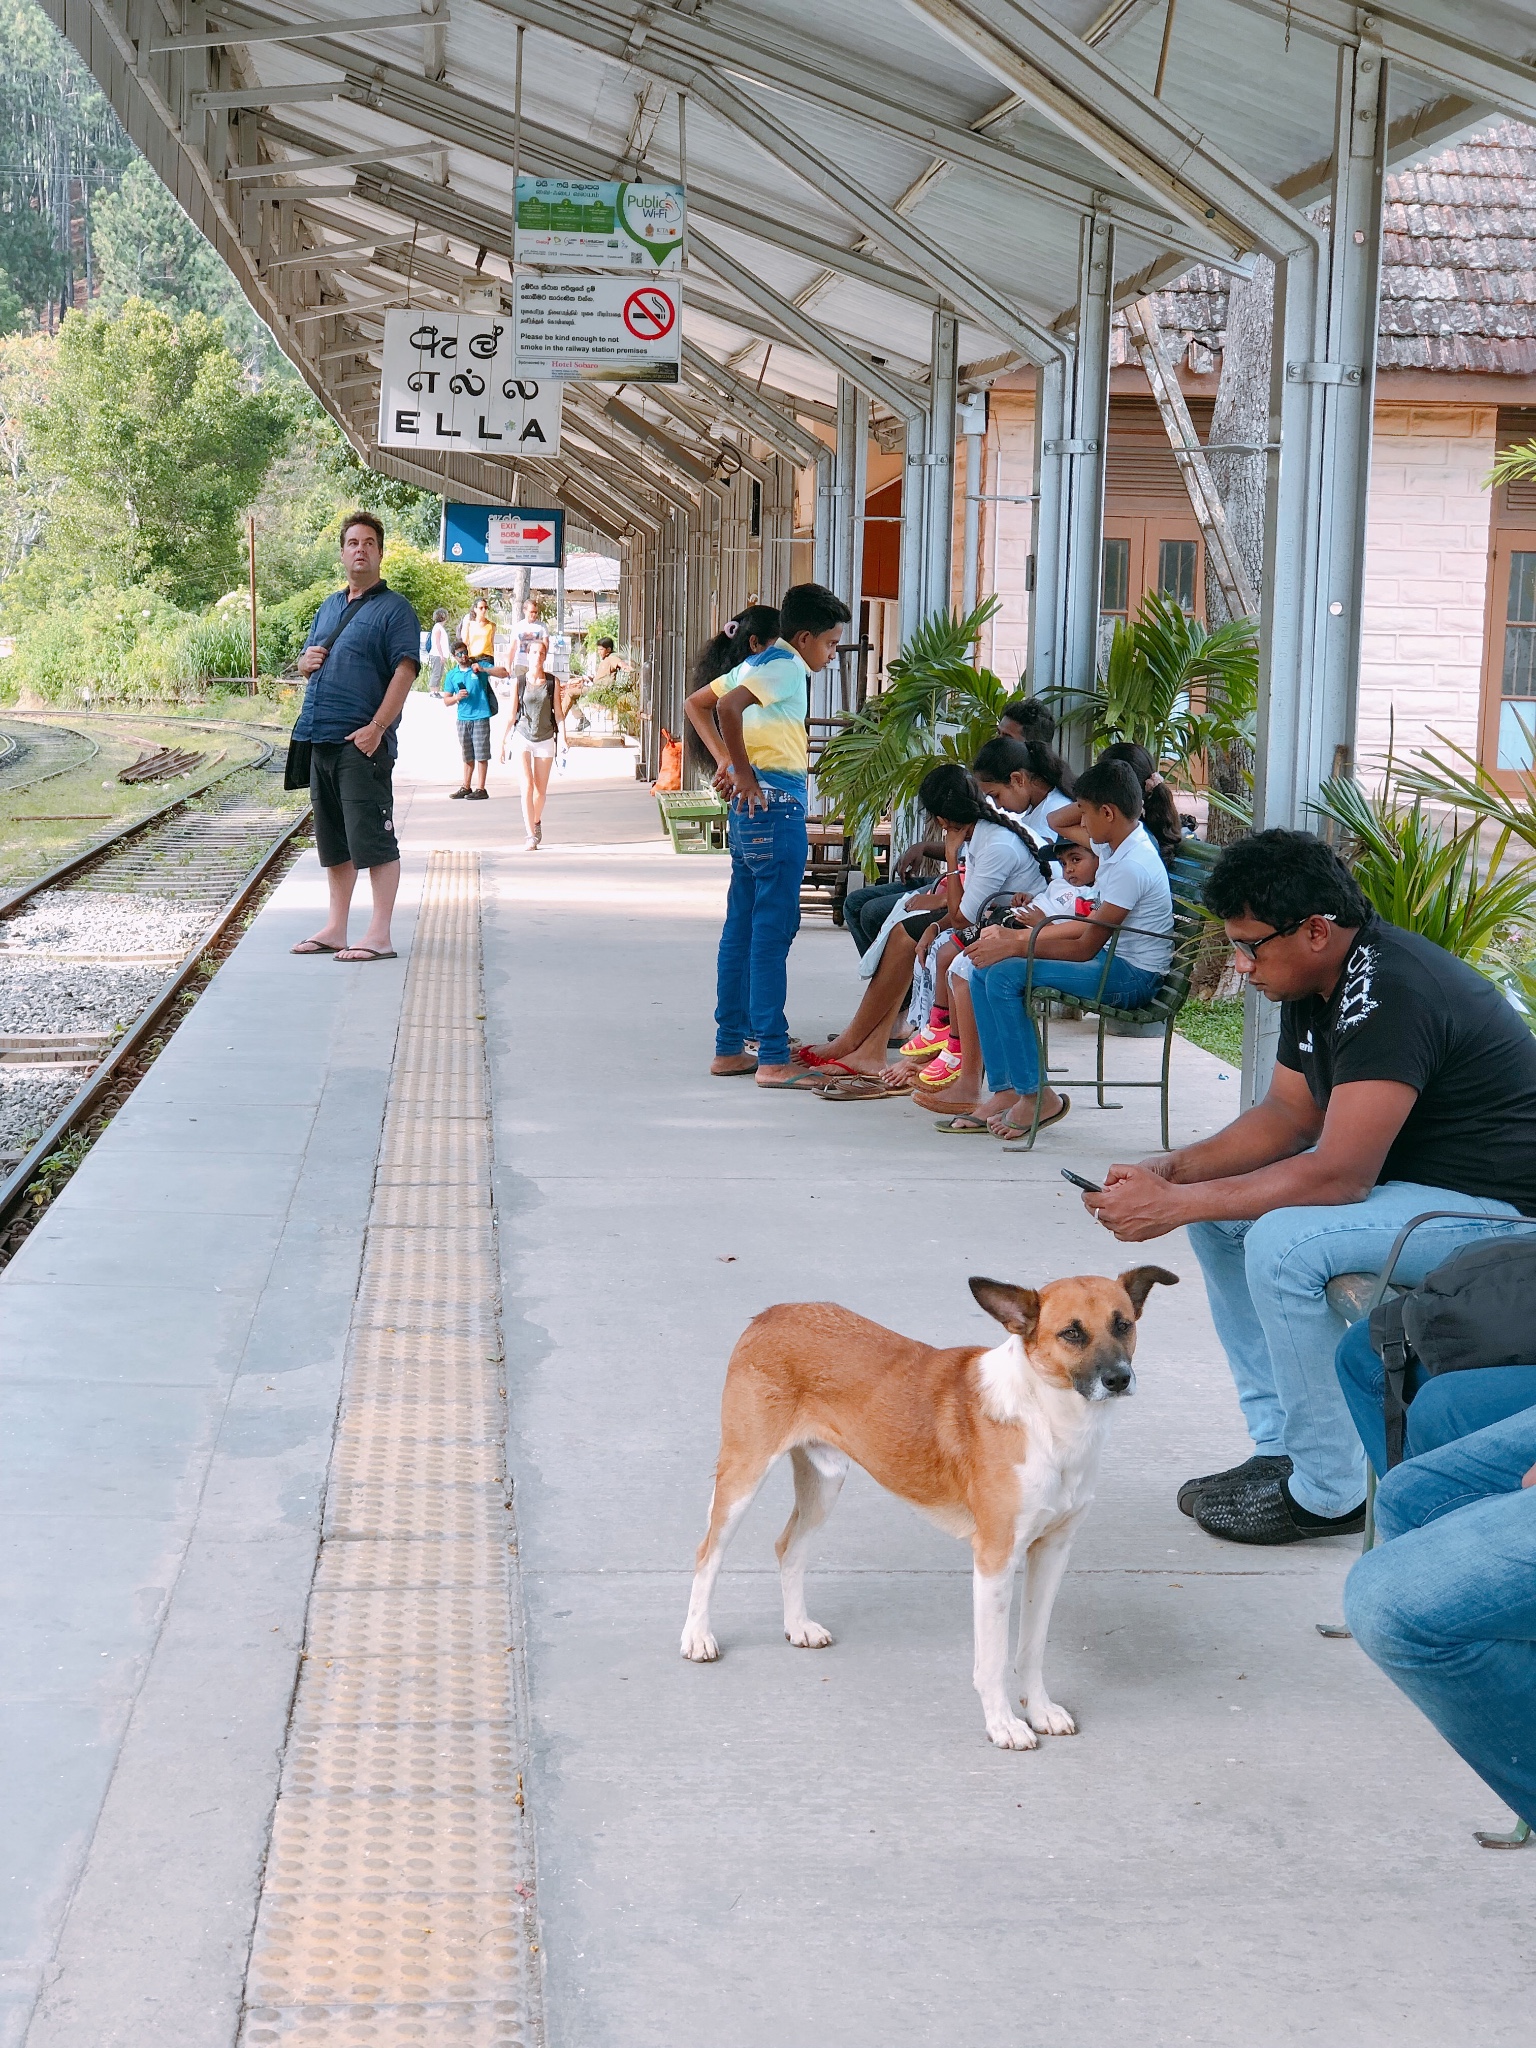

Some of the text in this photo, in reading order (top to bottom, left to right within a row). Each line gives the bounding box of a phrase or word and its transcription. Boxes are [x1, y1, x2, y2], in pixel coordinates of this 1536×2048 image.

[628, 194, 666, 208] Public
[643, 208, 666, 218] Wi-Fi
[572, 336, 598, 344] enough
[396, 410, 546, 442] ELLA
